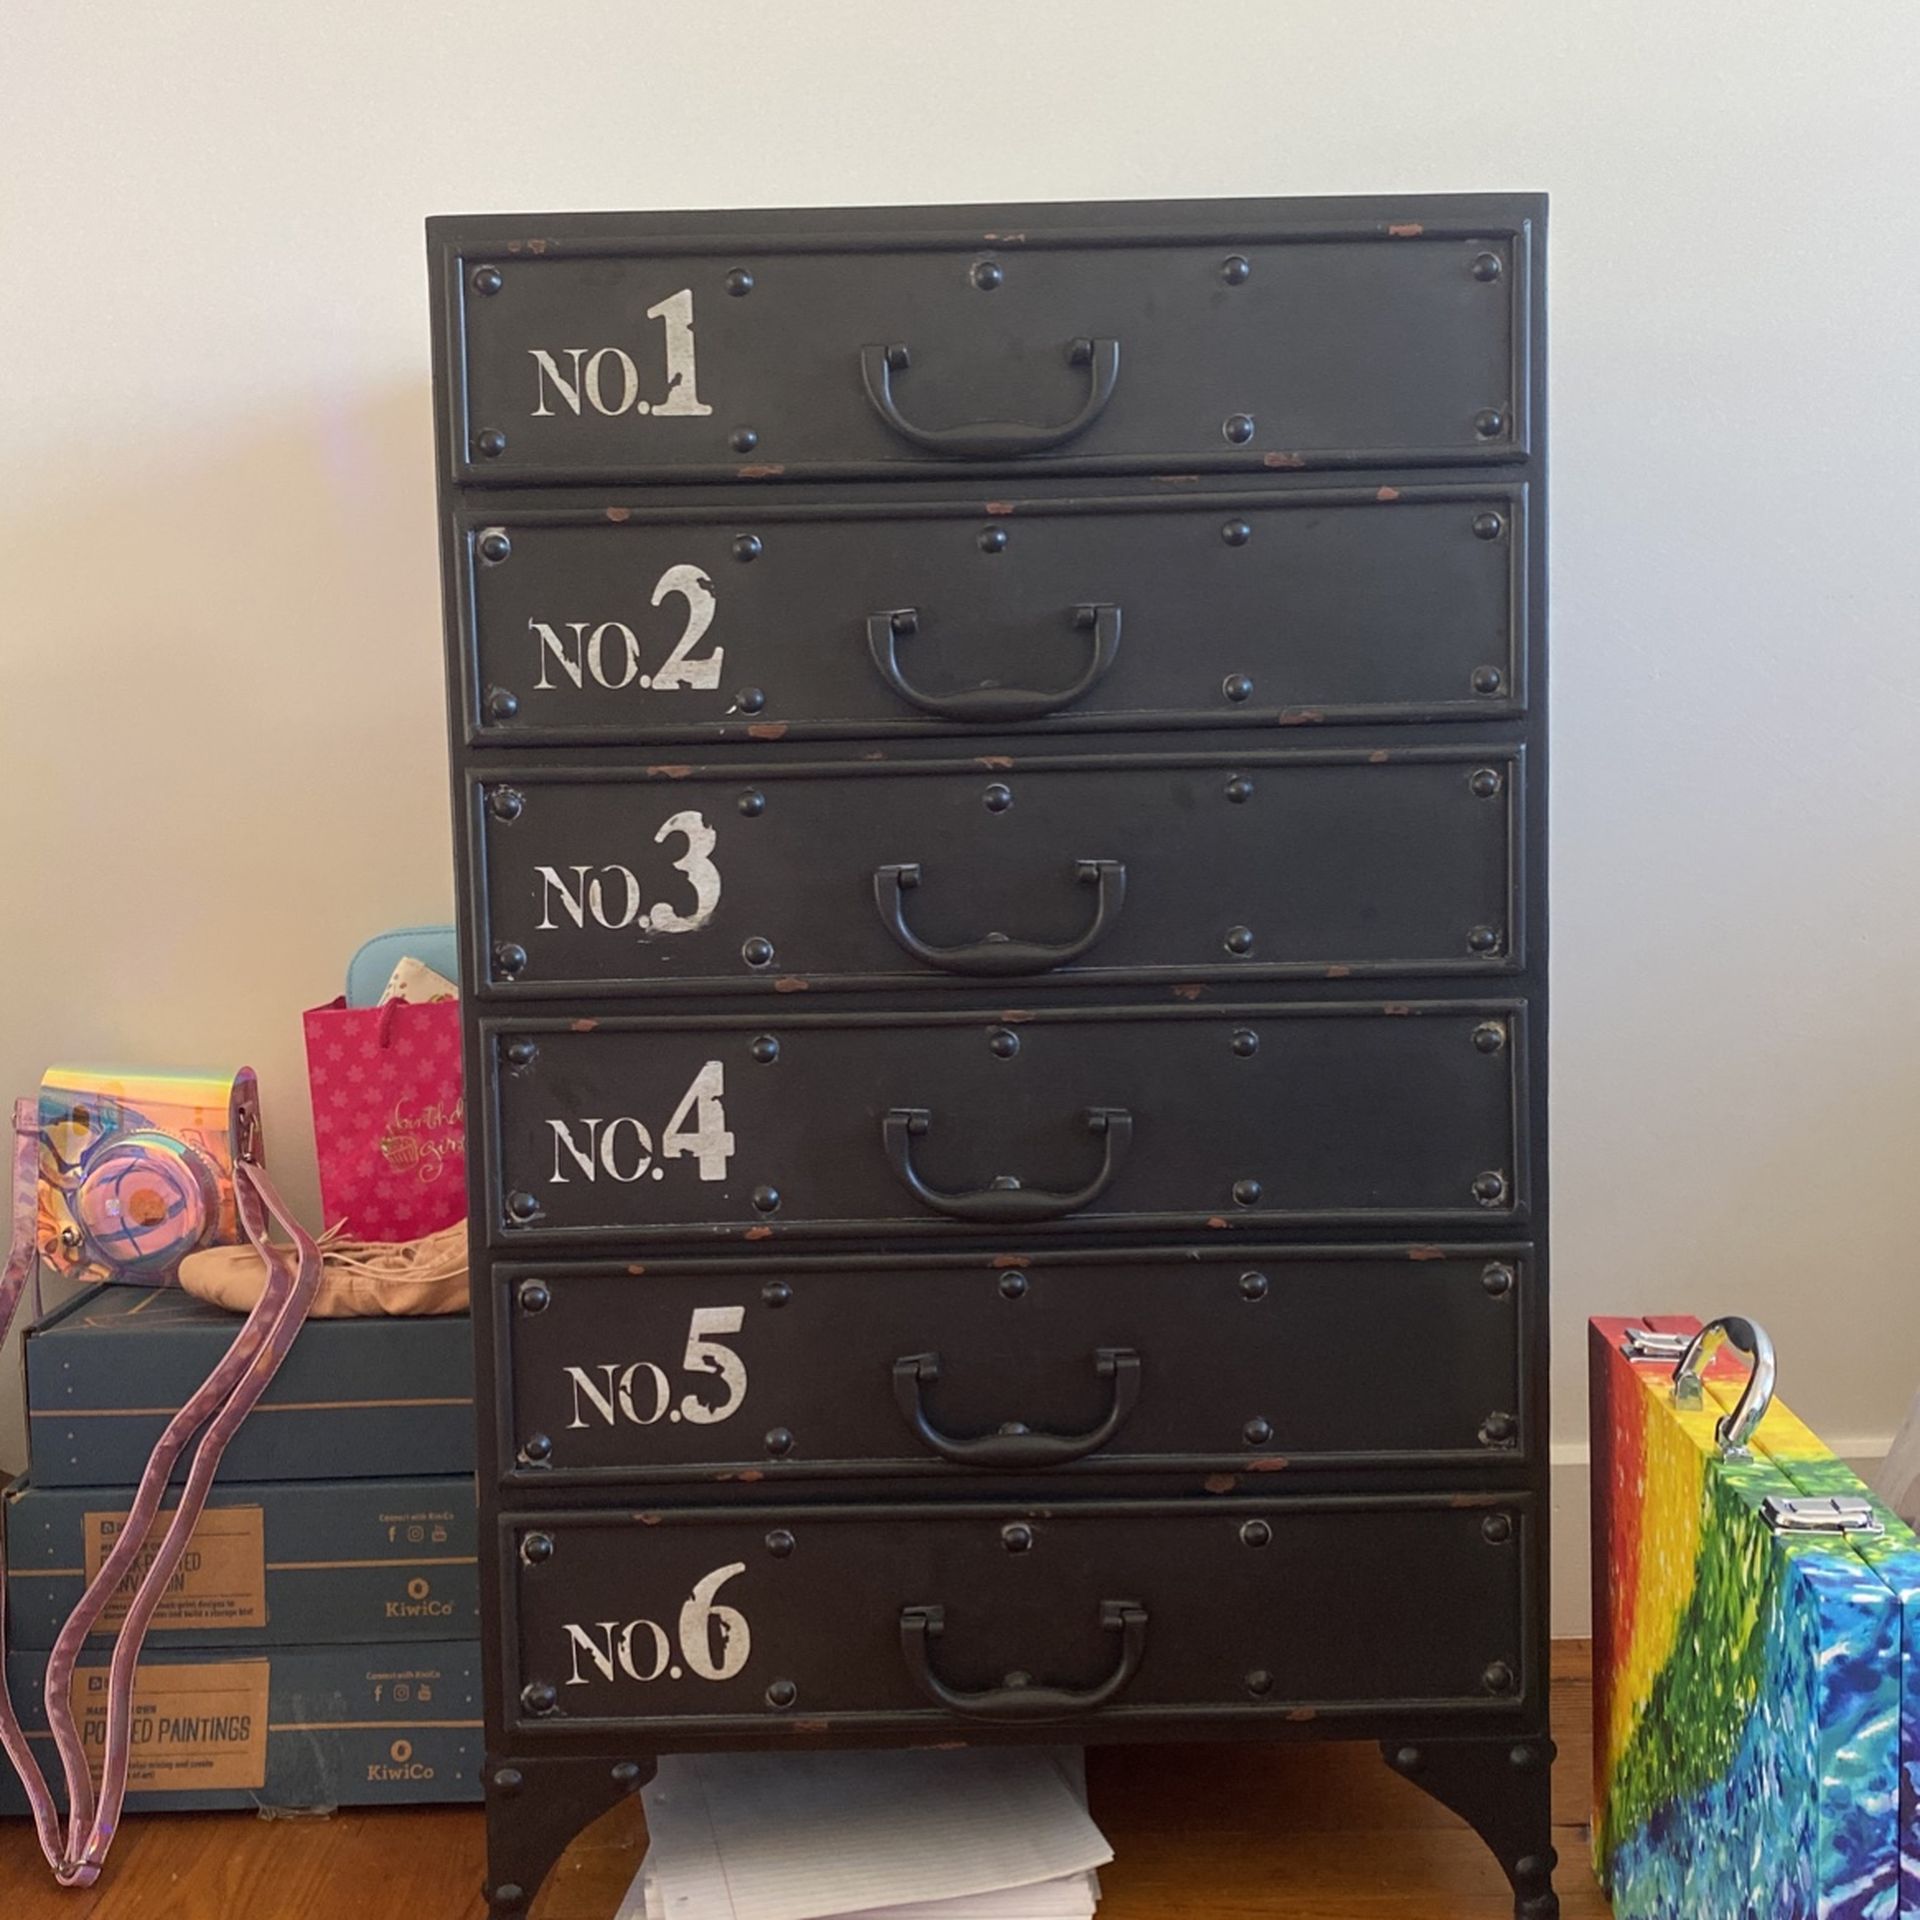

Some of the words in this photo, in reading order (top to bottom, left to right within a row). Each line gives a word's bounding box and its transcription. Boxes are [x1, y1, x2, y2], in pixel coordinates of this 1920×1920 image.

[528, 288, 713, 417] NO.1
[530, 563, 725, 690] NO.2
[533, 810, 722, 934] NO.3
[545, 1060, 735, 1183] NO.4
[562, 1305, 748, 1429] NO.5
[386, 1601, 453, 1617] KiwiCo
[561, 1561, 752, 1685] NO.6
[83, 1718, 153, 1745] POED
[158, 1715, 252, 1743] PAINTINGS
[367, 1763, 435, 1780] KiwiCo
